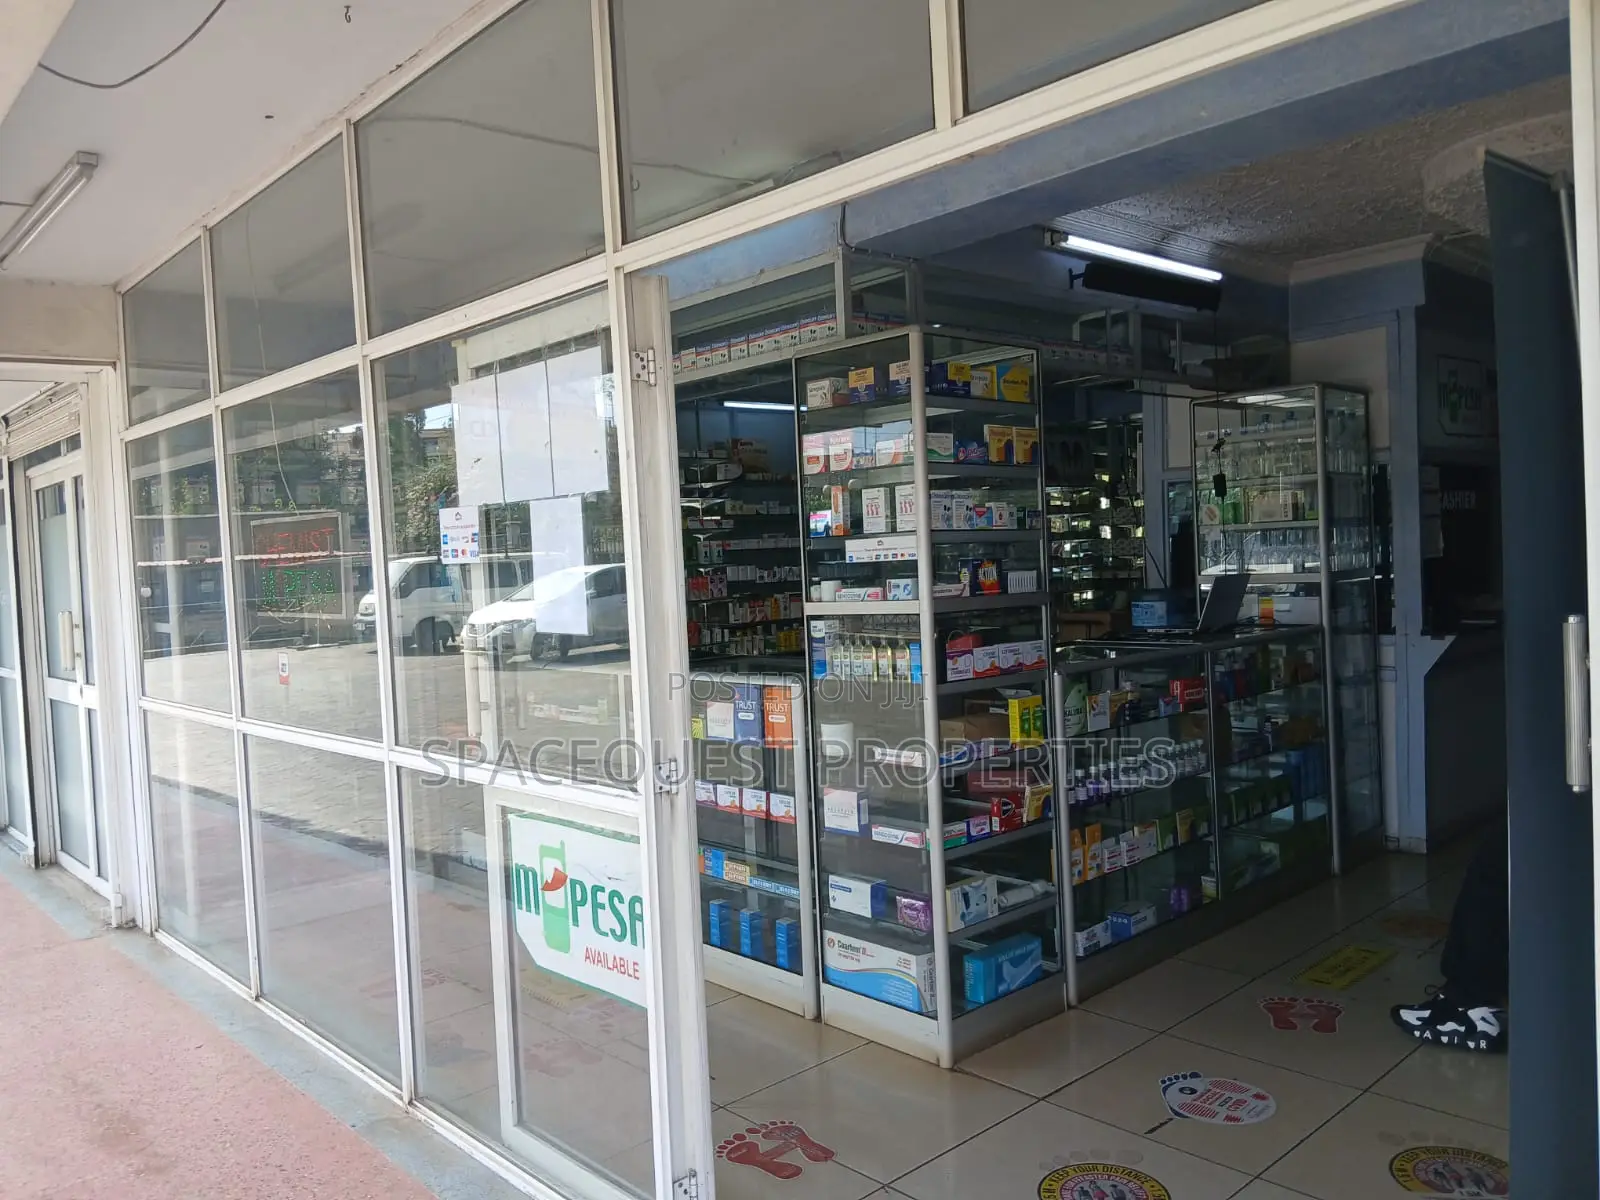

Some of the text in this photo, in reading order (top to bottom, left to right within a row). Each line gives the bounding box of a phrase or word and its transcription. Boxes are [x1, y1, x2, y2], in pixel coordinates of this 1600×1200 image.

[735, 700, 757, 710] TRUST
[765, 702, 789, 712] TRUST
[584, 947, 640, 981] AVAILABLE
[1072, 1164, 1100, 1174] YOUR
[1101, 1164, 1150, 1185] DISTANCE
